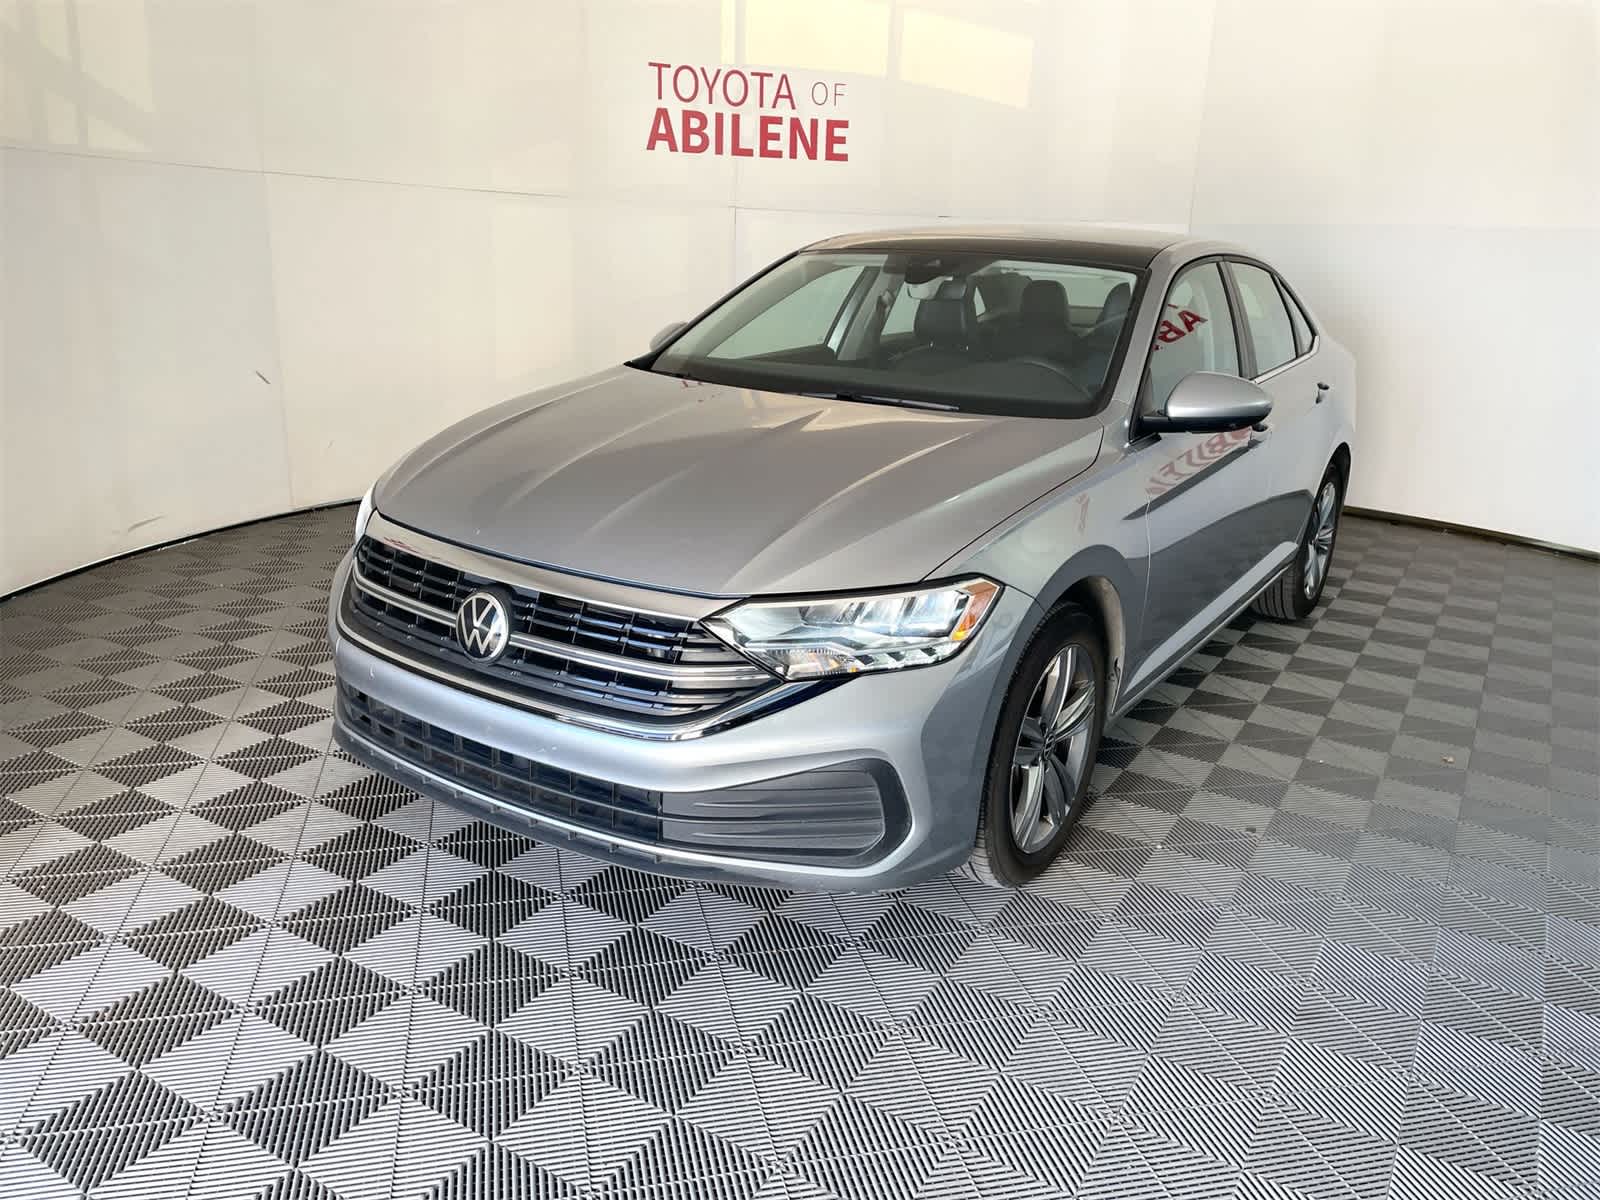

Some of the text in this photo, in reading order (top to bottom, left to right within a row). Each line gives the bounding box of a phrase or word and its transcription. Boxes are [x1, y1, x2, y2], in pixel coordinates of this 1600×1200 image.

[648, 62, 846, 110] TOYOTA OF
[646, 107, 849, 162] ABILENE
